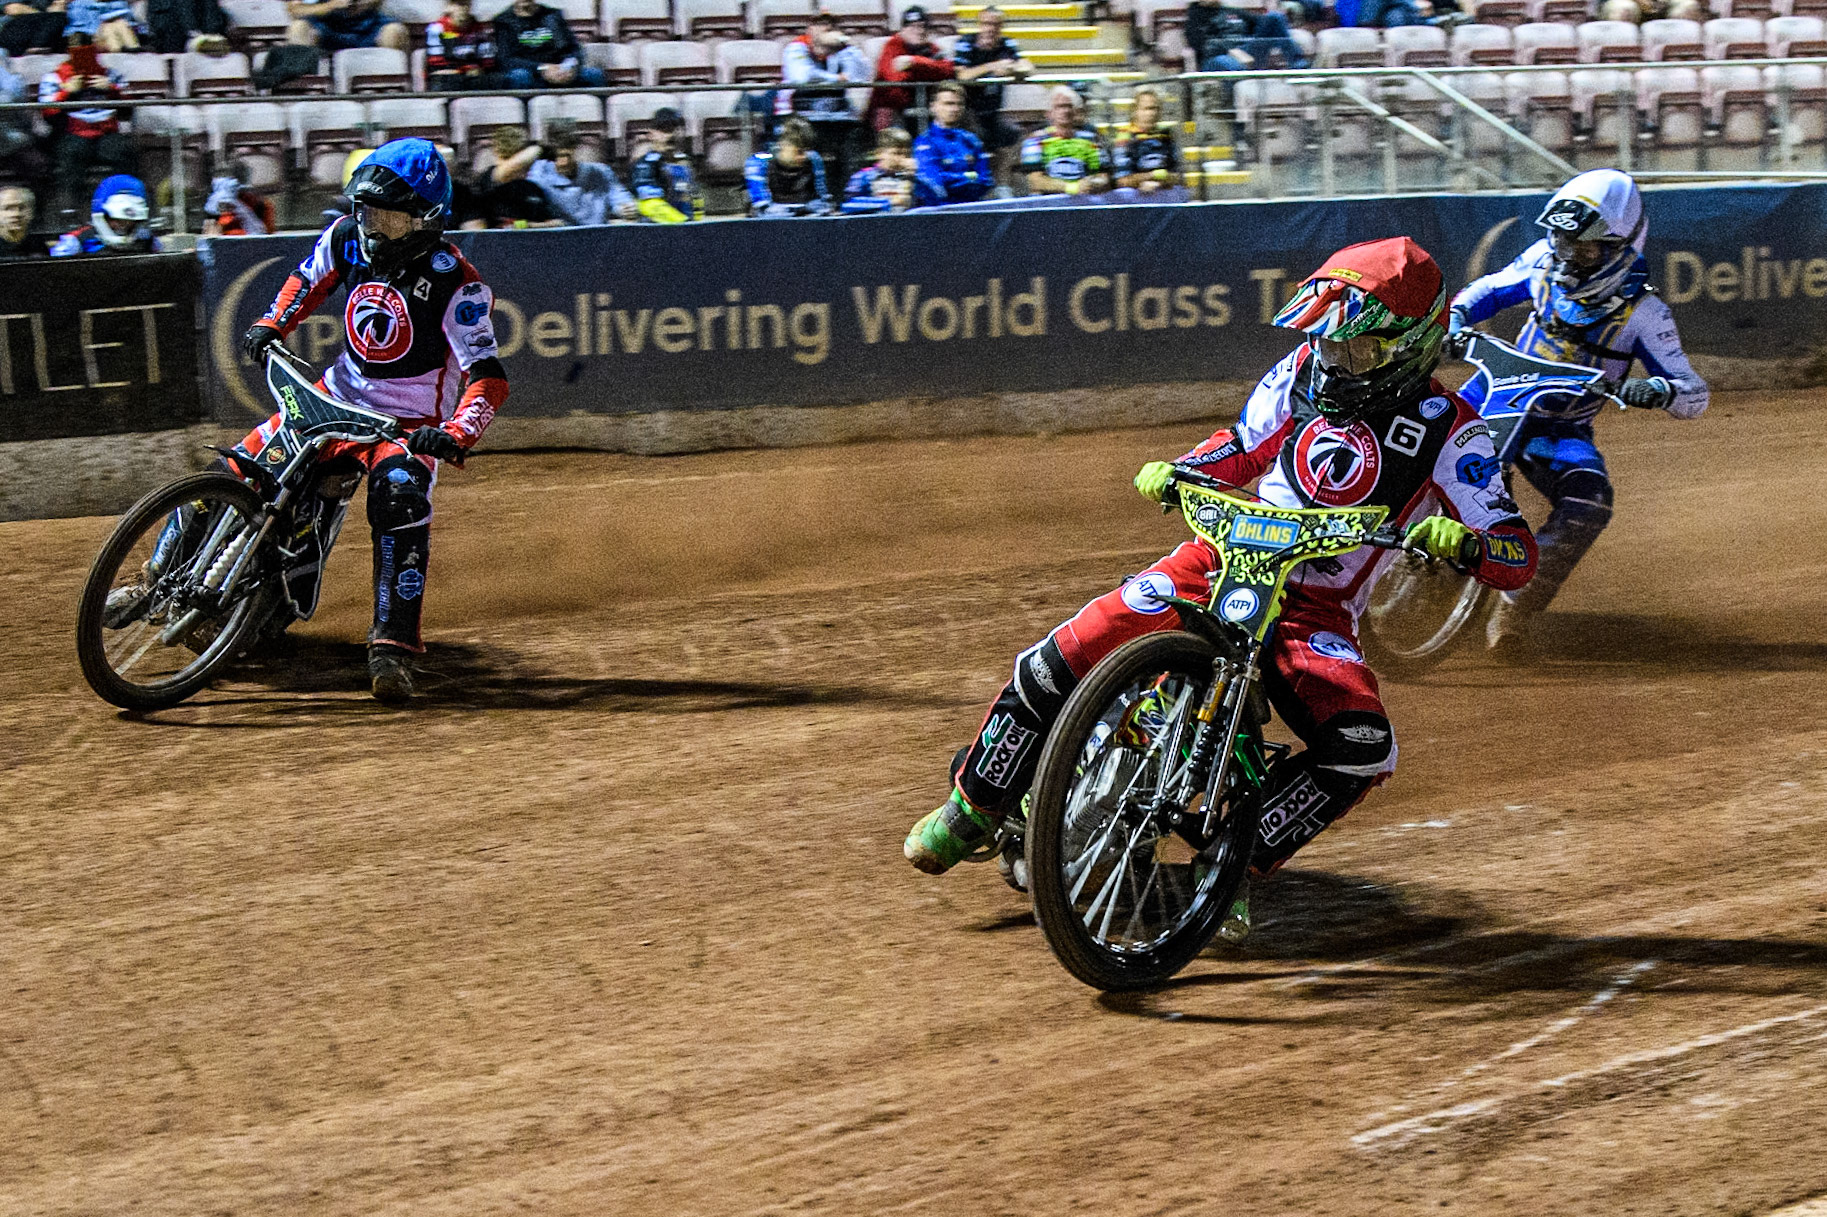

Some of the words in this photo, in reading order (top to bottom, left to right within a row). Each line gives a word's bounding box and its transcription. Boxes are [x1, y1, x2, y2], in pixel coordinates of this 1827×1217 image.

[415, 279, 430, 299] 4
[493, 290, 830, 365] Delivering
[851, 275, 1047, 344] World
[1069, 272, 1231, 334] Class
[1249, 268, 1297, 324] T
[280, 385, 304, 420] FORK
[1425, 400, 1443, 412] ATPI
[1313, 420, 1334, 435] BEL
[1361, 435, 1375, 469] COLTS
[1388, 420, 1423, 453] 6
[1235, 517, 1293, 544] ÖHLINS
[1227, 599, 1252, 611] ATPI
[984, 740, 1015, 785] ROCK
[1006, 724, 1027, 747] OIL
[1280, 782, 1318, 821] ROCK
[1261, 811, 1283, 838] OIL
